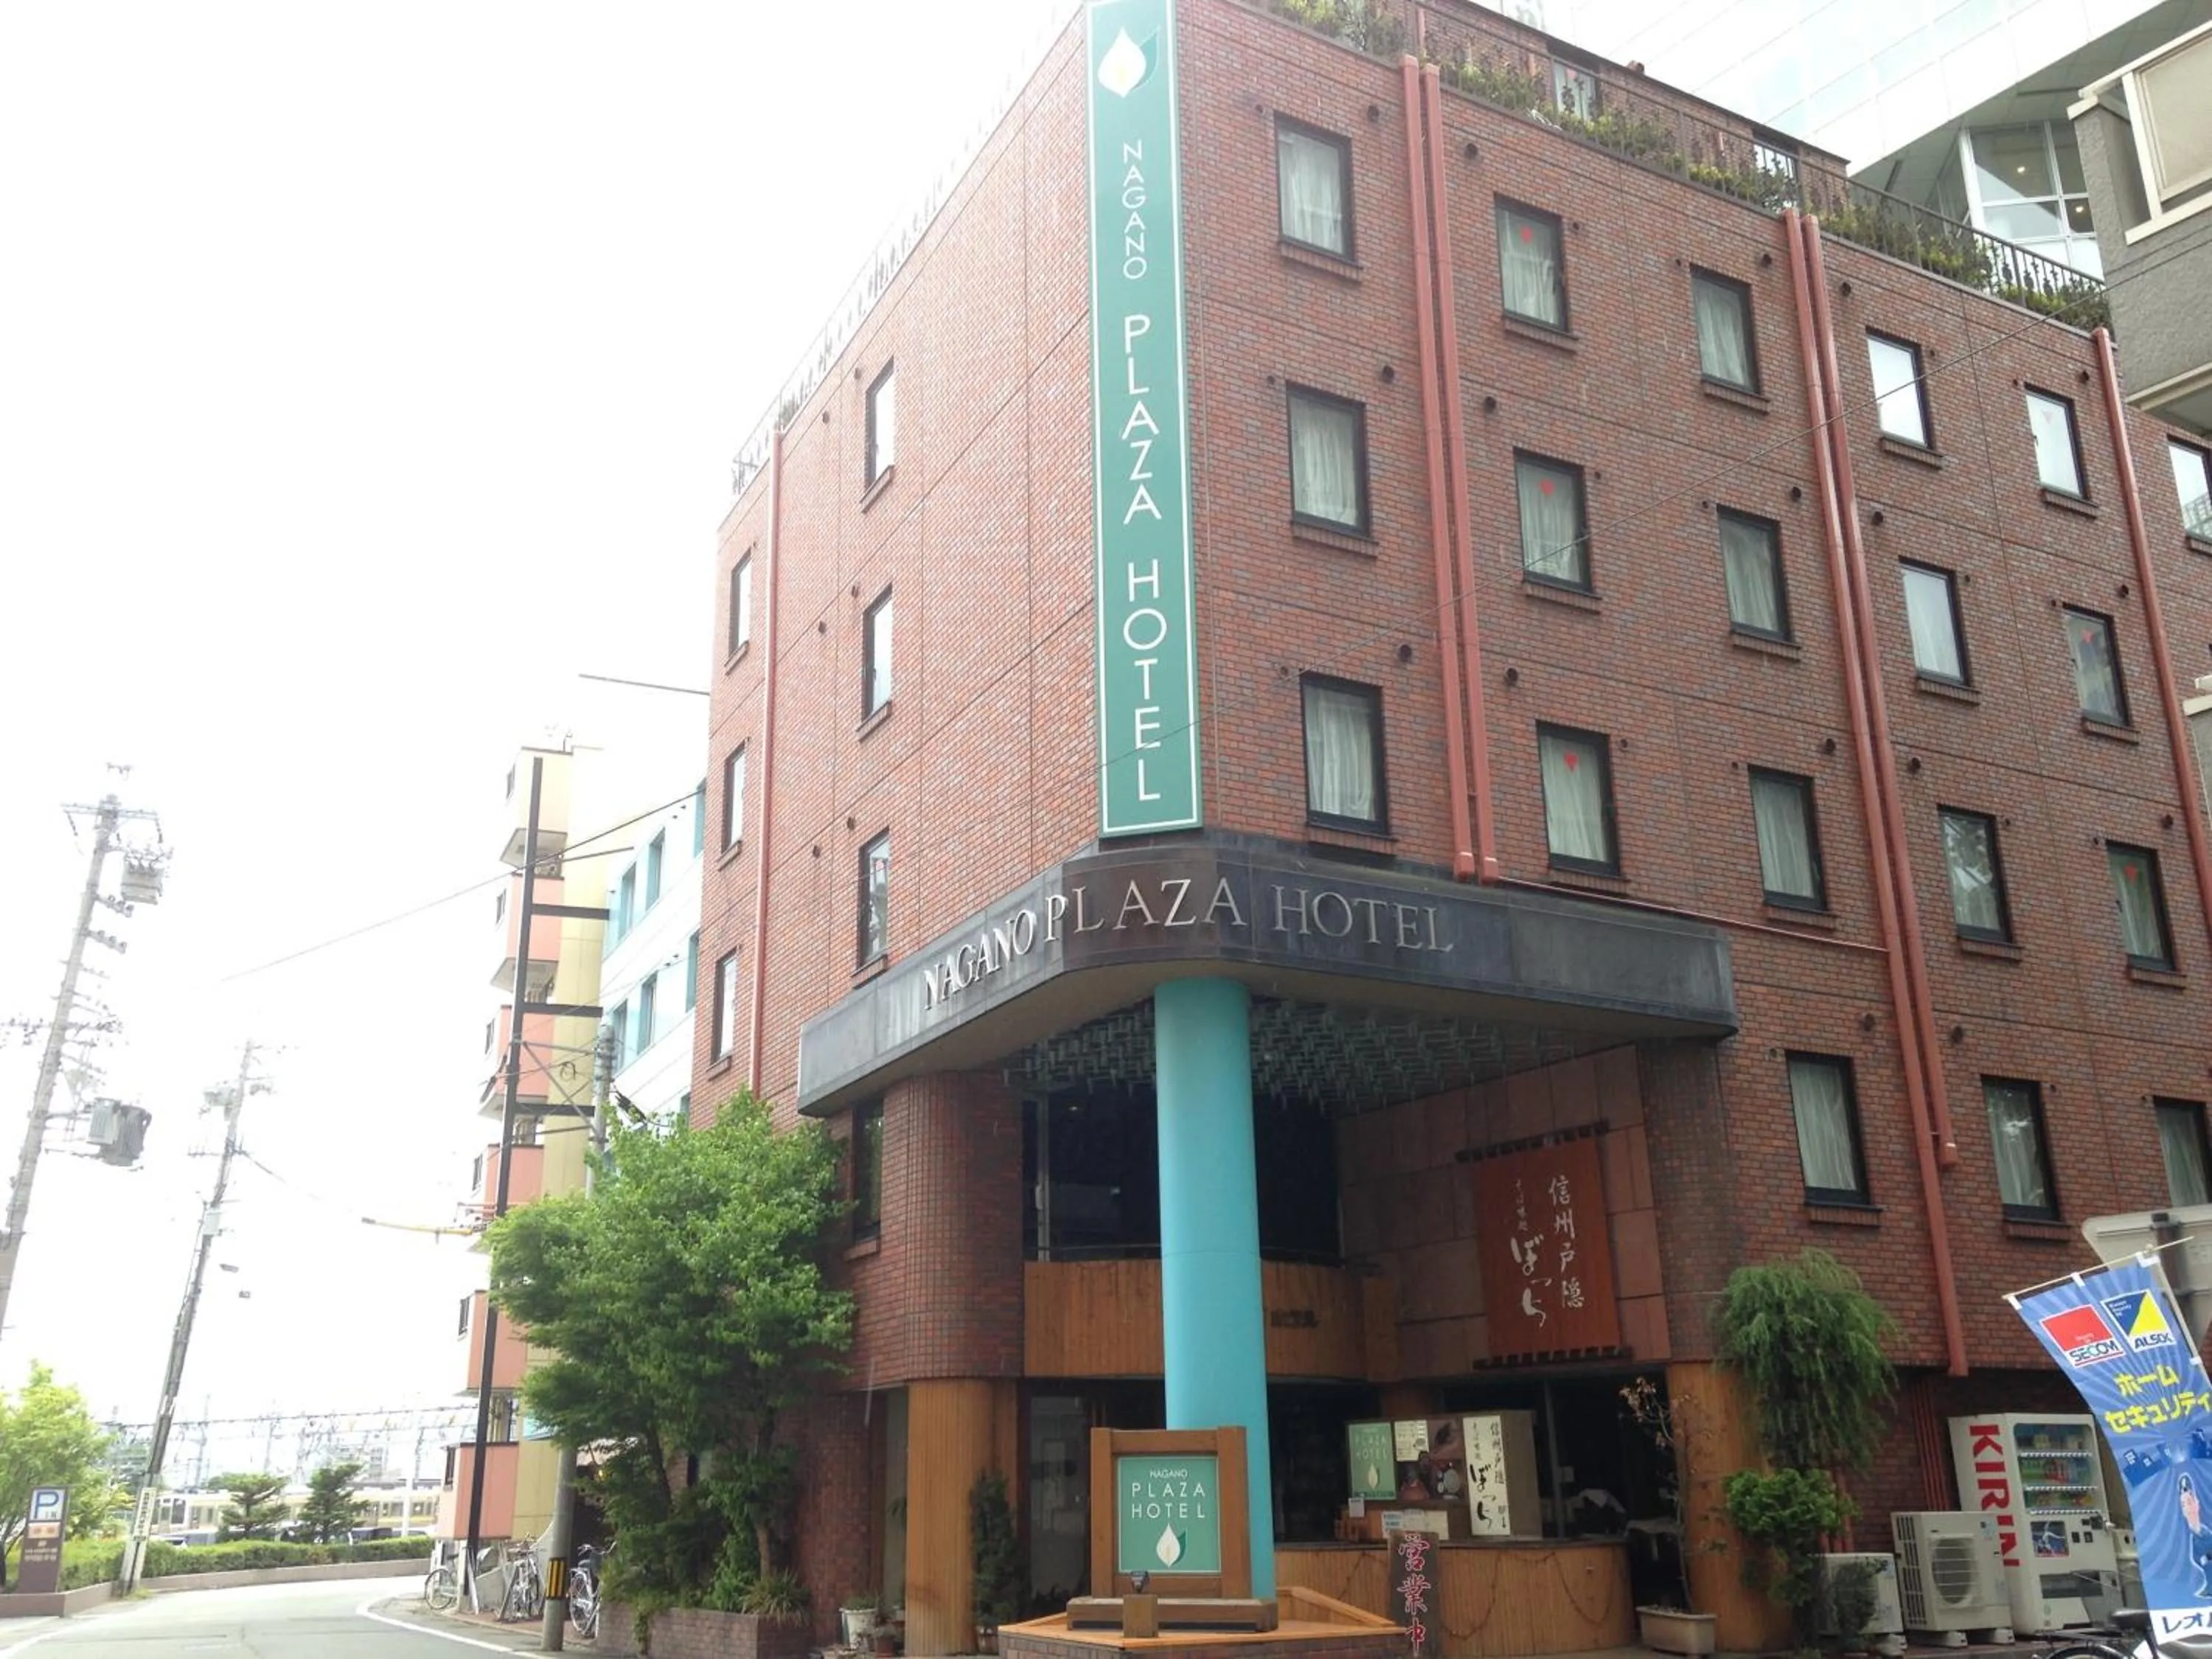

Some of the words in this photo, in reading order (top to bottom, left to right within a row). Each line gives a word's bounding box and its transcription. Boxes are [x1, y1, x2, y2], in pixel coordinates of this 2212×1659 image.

[1122, 139, 1147, 279] NAGANO
[1121, 314, 1161, 524] PLAZA
[1123, 558, 1166, 801] HOTEL
[922, 908, 1037, 1010] NAGANO
[1043, 876, 1247, 943] PLAZA
[1273, 884, 1455, 953] HOTEL
[1549, 1175, 1585, 1309] 信州戸隠
[2069, 1340, 2120, 1362] SECOM
[2114, 1364, 2180, 1398] ホーム
[2104, 1391, 2212, 1433] セキュリティ
[34, 1491, 60, 1519] P
[1132, 1482, 1206, 1498] PLAZA
[1132, 1503, 1206, 1519] HOTEL
[1150, 1468, 1188, 1478] NAGANO
[1969, 1424, 2020, 1567] KIRIN
[1397, 1533, 1432, 1657] 営業中
